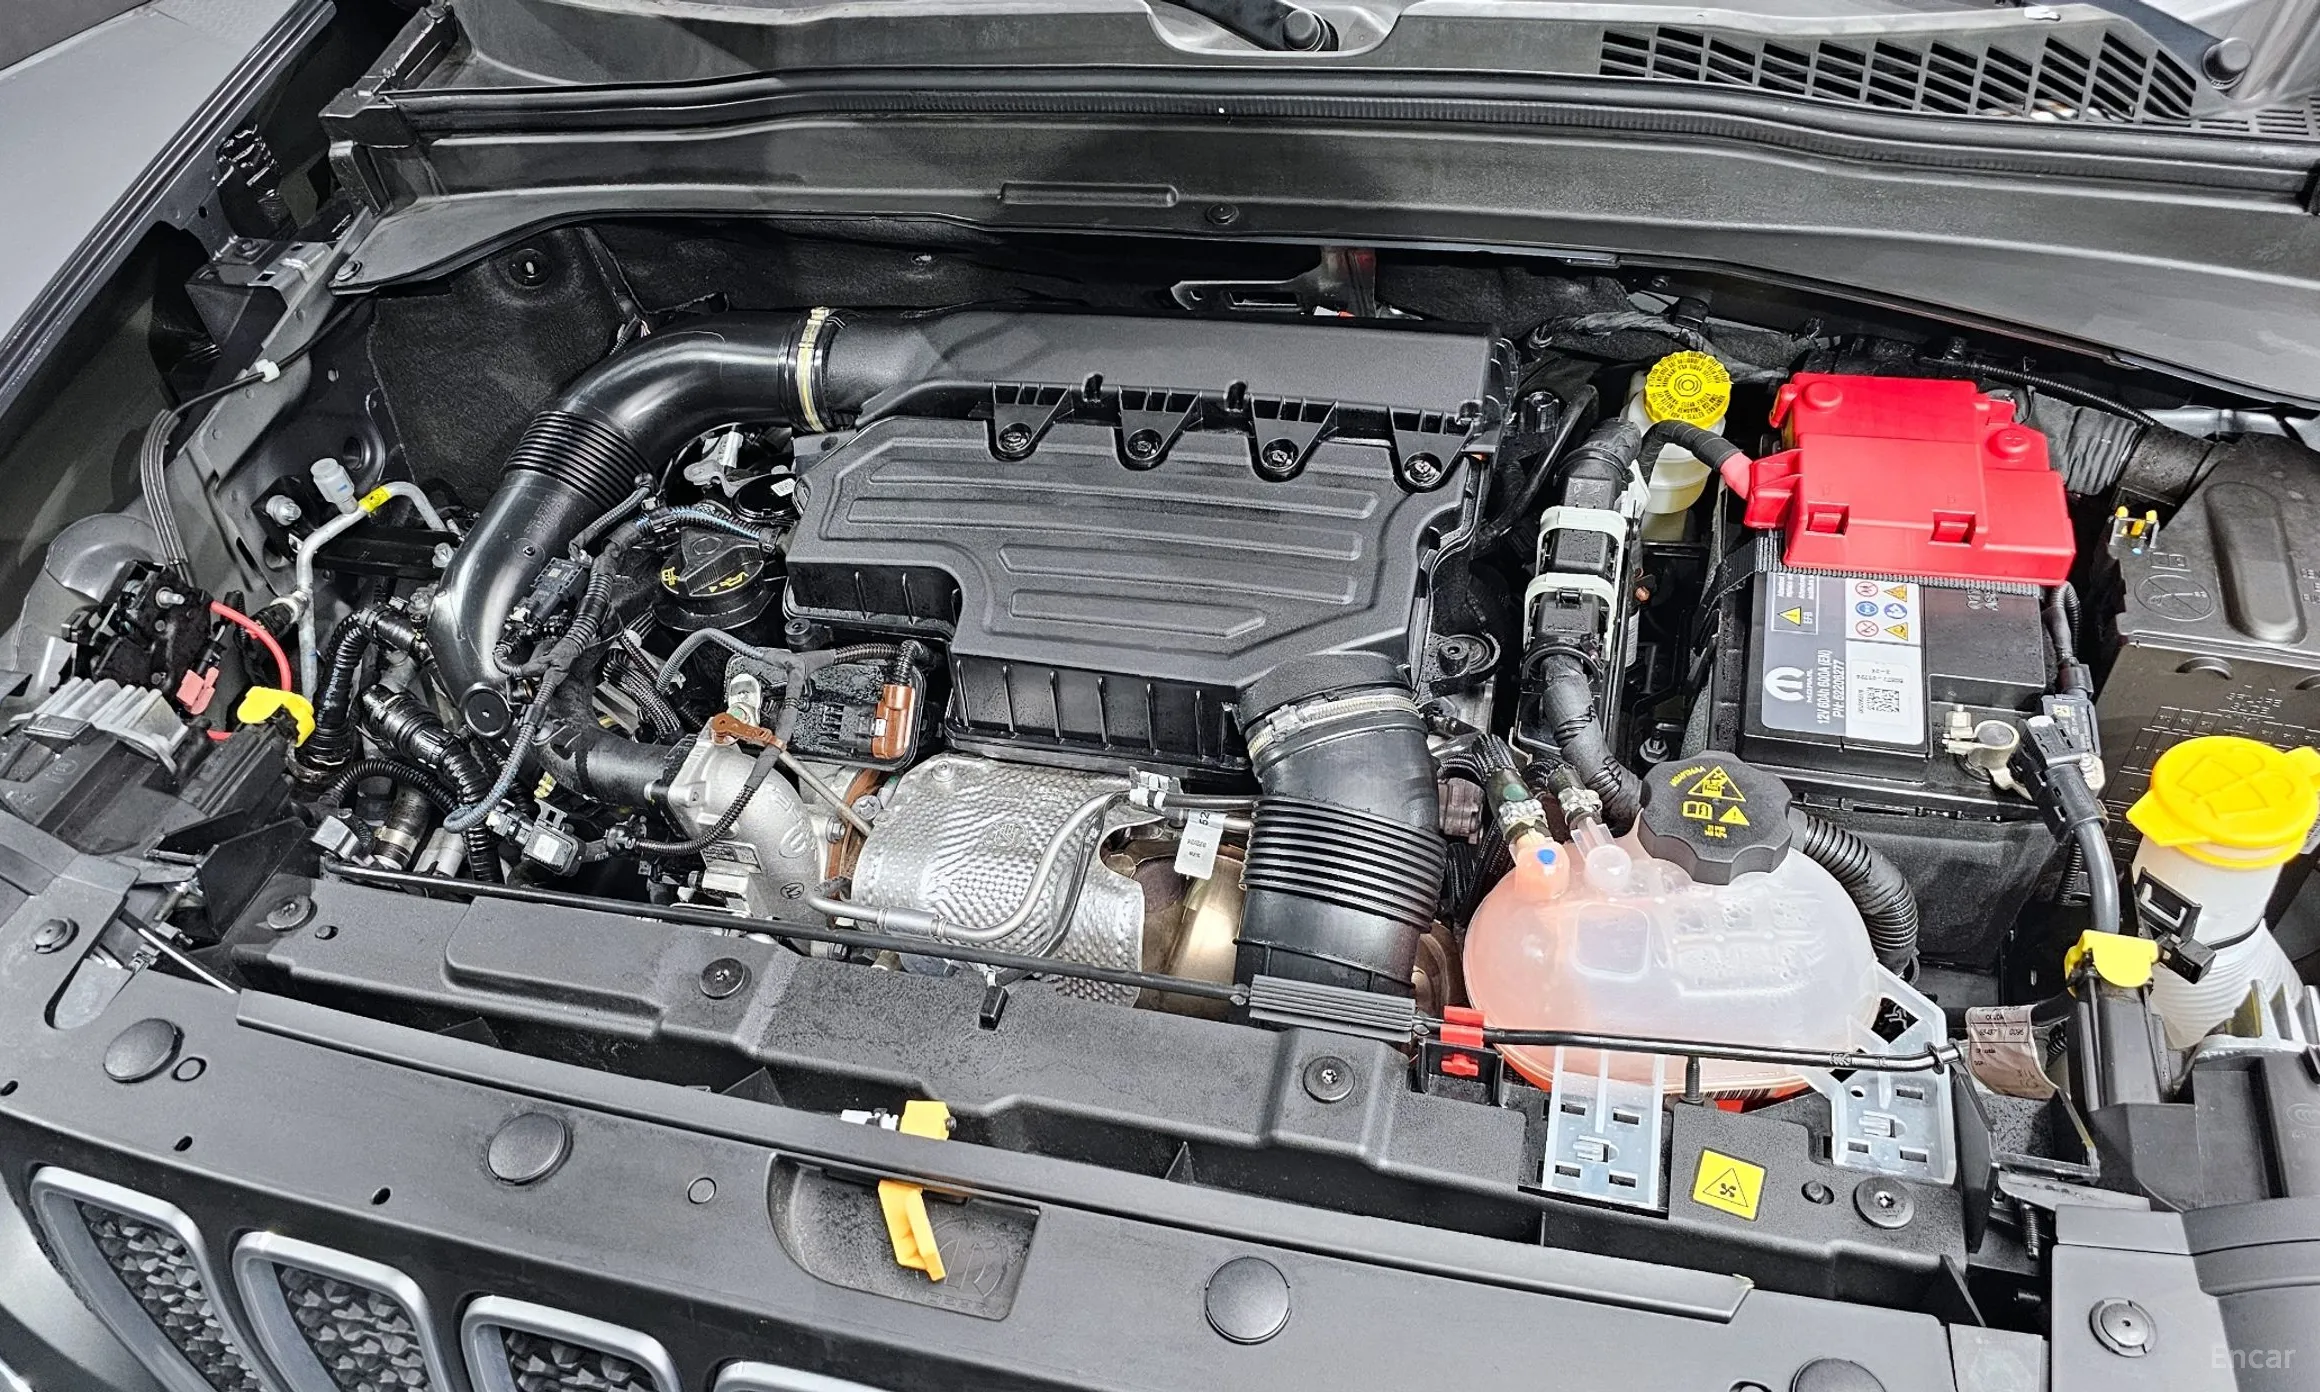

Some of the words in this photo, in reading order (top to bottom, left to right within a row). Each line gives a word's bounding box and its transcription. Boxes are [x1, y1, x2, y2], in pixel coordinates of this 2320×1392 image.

[1817, 649, 1833, 666] (EN)
[1817, 666, 1831, 687] 600A
[1805, 668, 1813, 704] MOPAR
[1816, 688, 1831, 708] 60Ah
[1816, 708, 1830, 724] 12V
[1198, 811, 1211, 826] 52
